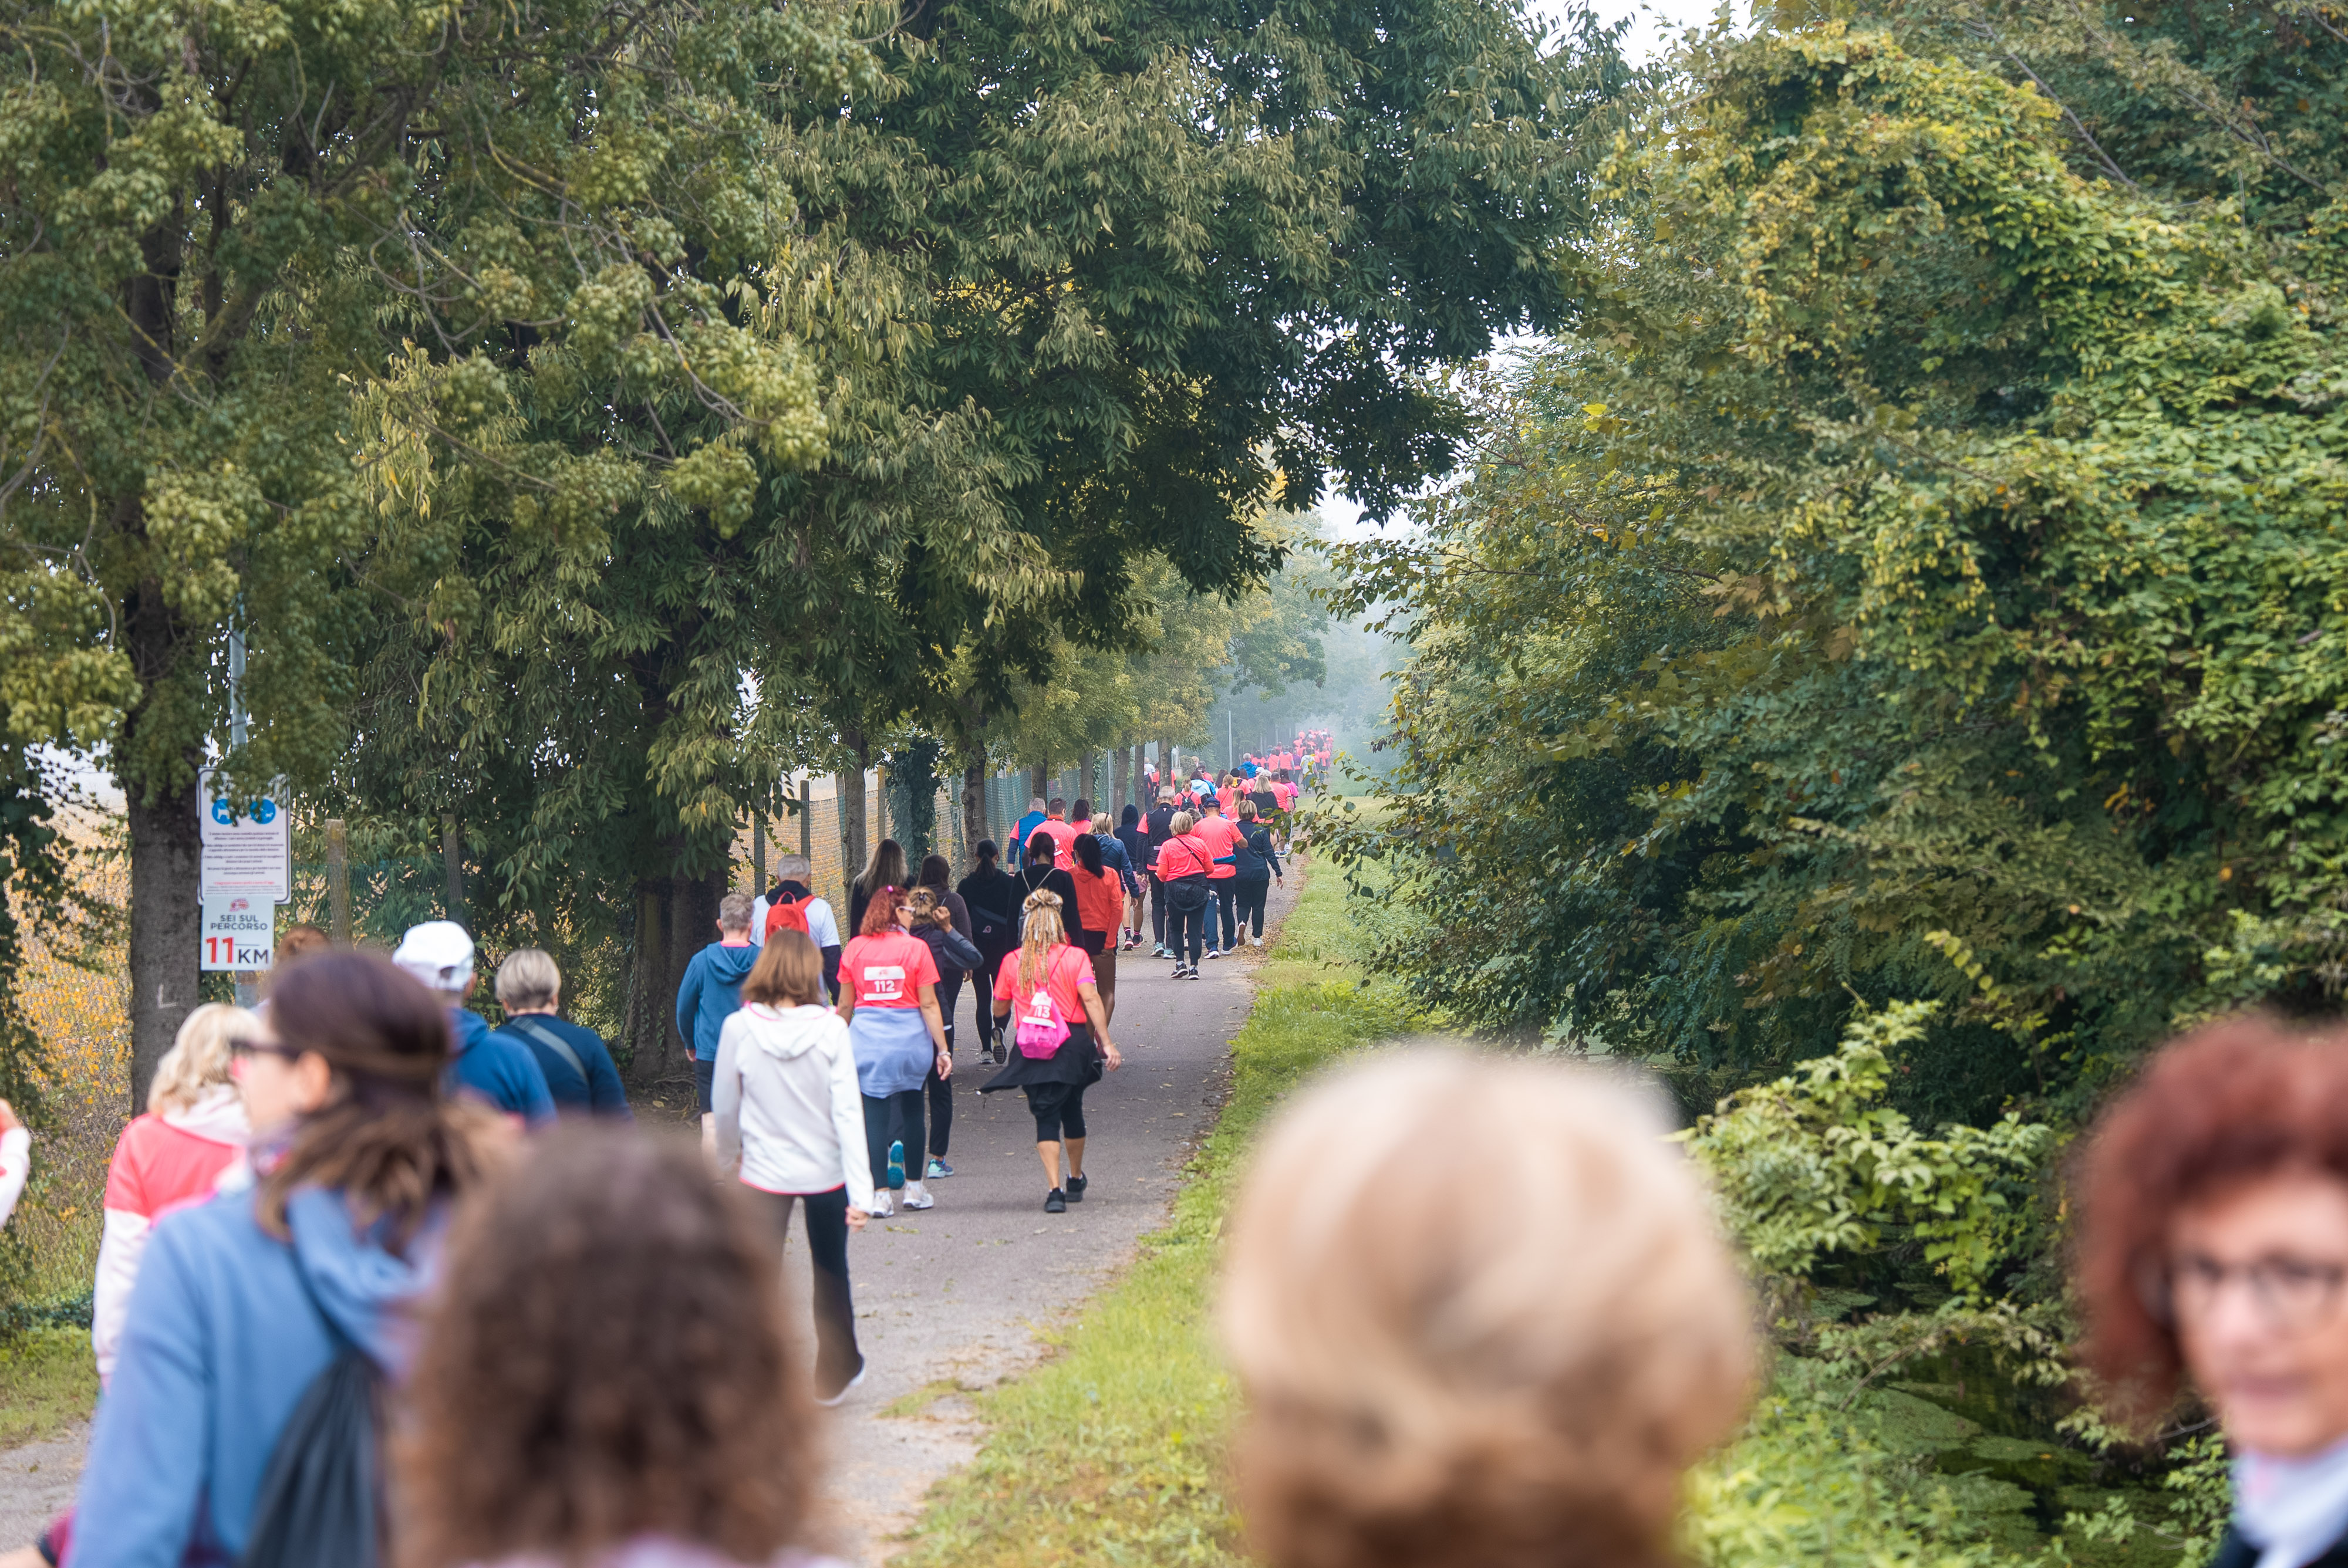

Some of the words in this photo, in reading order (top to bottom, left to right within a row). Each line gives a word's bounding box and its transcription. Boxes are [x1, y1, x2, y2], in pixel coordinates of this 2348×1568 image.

[206, 937, 234, 964] 11
[238, 948, 269, 964] KM
[874, 980, 895, 992] 112
